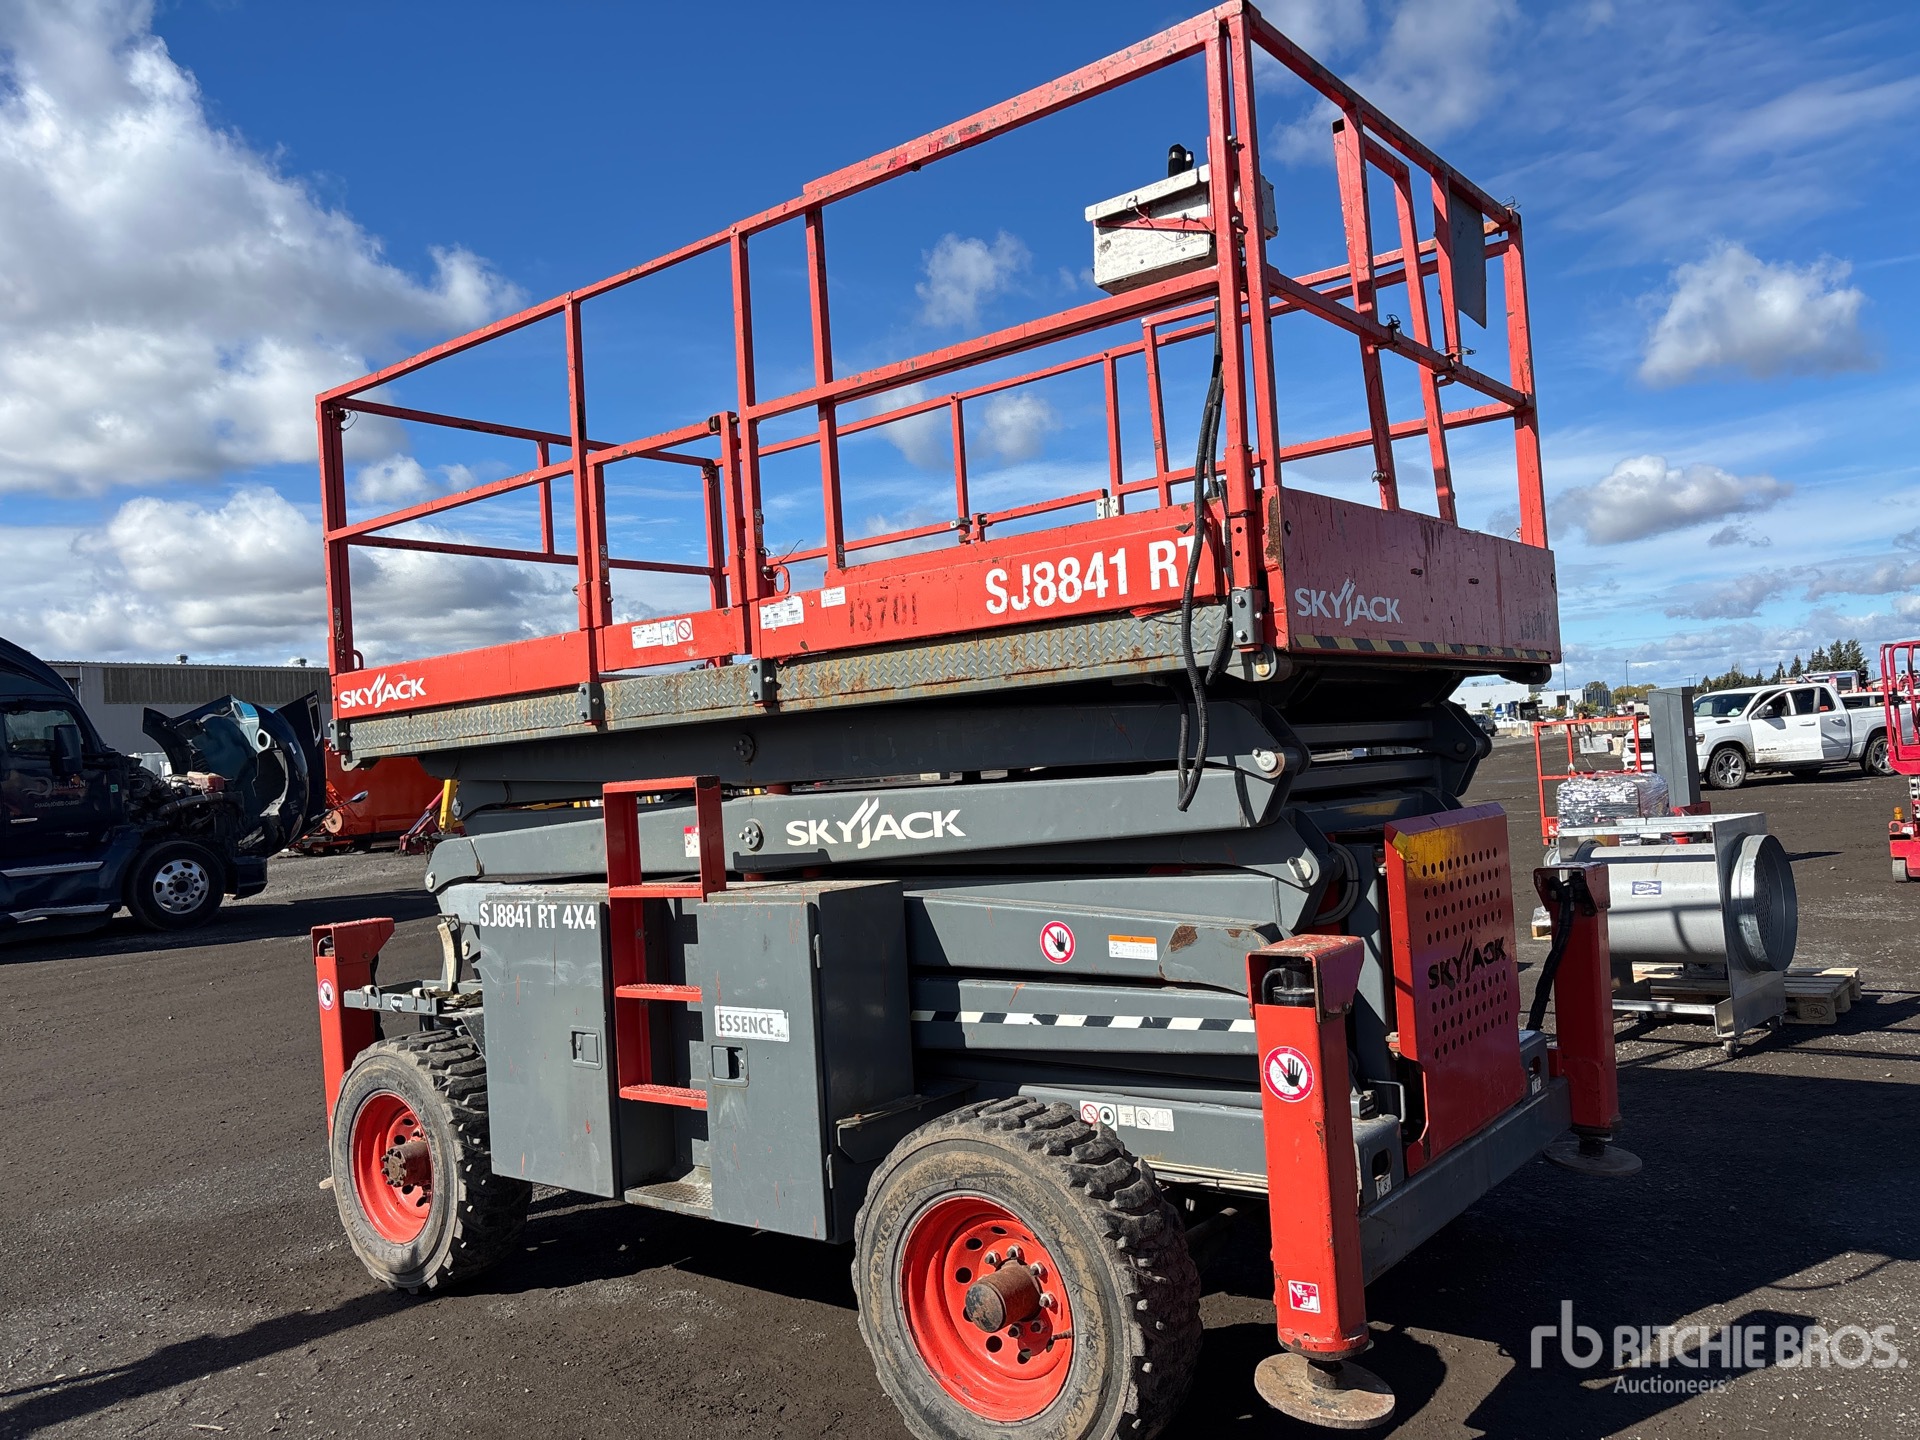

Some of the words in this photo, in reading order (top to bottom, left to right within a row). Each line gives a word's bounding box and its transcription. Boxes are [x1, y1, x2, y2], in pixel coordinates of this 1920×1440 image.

[985, 548, 1128, 615] SJ8841
[1148, 535, 1205, 591] RT
[1294, 576, 1403, 627] SKYJACK
[340, 673, 426, 709] SKYJACK
[786, 797, 966, 849] SKYJACK
[480, 903, 531, 928] SJ8841
[538, 904, 557, 929] RT
[562, 905, 597, 930] 4X4
[1428, 935, 1507, 990] SKYJACK
[719, 1014, 774, 1034] ESSENCE
